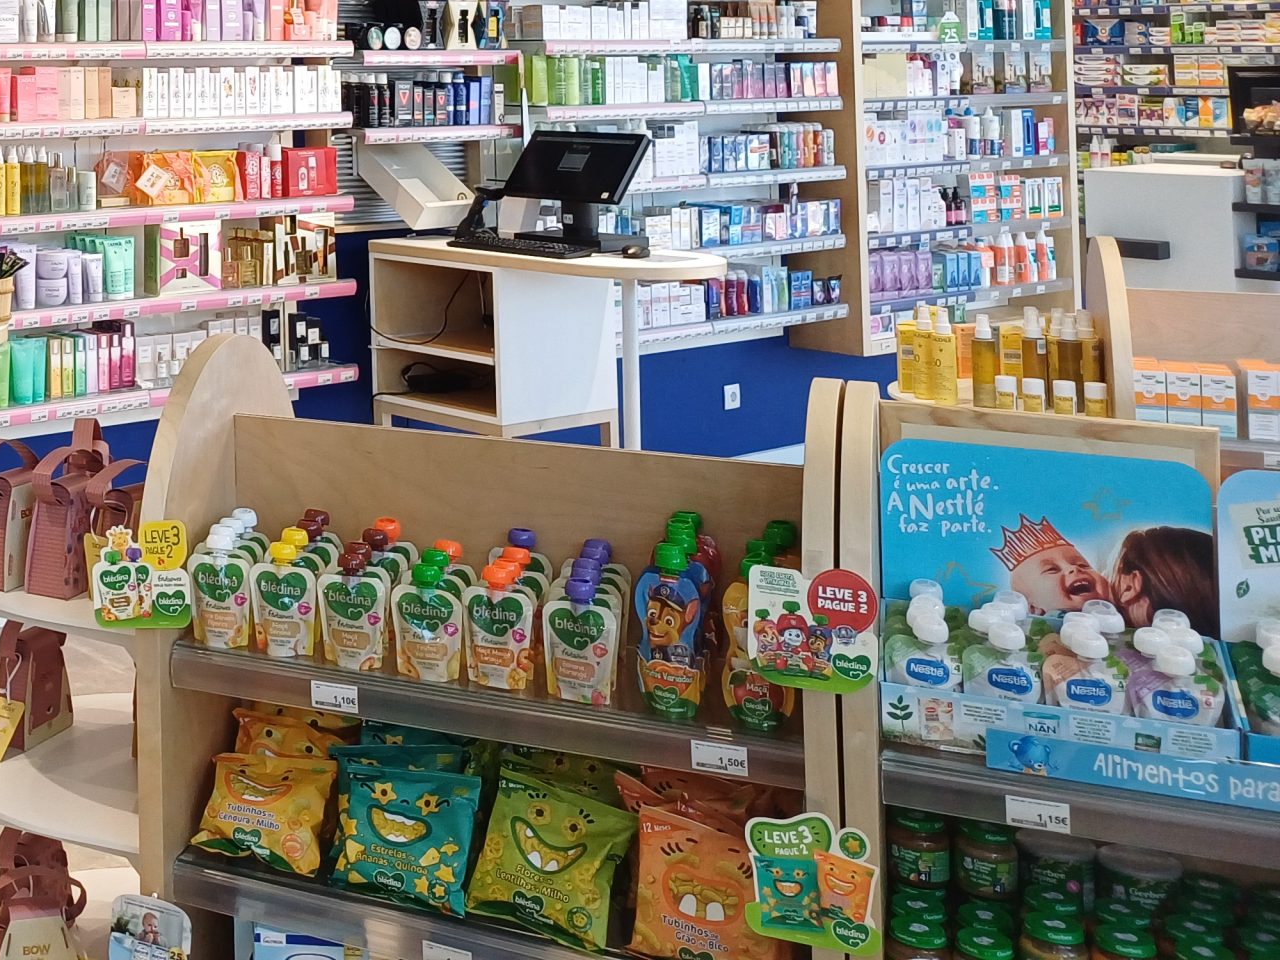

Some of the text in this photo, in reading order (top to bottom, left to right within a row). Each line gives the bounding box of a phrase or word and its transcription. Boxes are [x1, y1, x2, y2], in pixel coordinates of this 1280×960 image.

[887, 454, 950, 476] Crescer
[894, 469, 1000, 492] é uma arte.
[887, 492, 985, 520] A Nestlé
[898, 517, 993, 538] faz parte.
[145, 525, 181, 546] LEVE 3
[145, 544, 173, 558] PAGUE 2
[198, 572, 238, 587] blédina
[260, 580, 301, 596] blédina
[818, 586, 867, 603] LEVE 3
[328, 591, 371, 606] blédina
[817, 598, 868, 614] PAGUE 2
[402, 602, 448, 618] blédina
[473, 604, 517, 622] blédina
[554, 617, 598, 636] blédina
[835, 660, 867, 671] blédina
[910, 663, 944, 677] Nestlé
[992, 673, 1028, 686] Nestlé
[1070, 684, 1108, 697] Nestlé
[1156, 695, 1194, 710] Nestlé
[1028, 723, 1057, 735] NAN
[718, 757, 746, 772] 1,50€
[1093, 752, 1280, 803] Alimentos para
[227, 803, 267, 817] Tubinhos
[257, 819, 281, 831] Milho
[1036, 812, 1069, 827] 1,15€
[764, 825, 813, 845] LEVE 3
[371, 844, 407, 859] Estrelas
[775, 844, 808, 856] PAGUE 2
[396, 862, 428, 875] Quinoa
[516, 864, 545, 884] Flores
[496, 868, 570, 904] Lentilhas Milho
[662, 915, 710, 938] Tubinhos
[836, 925, 866, 940] blédina
[708, 940, 729, 953] Bico
